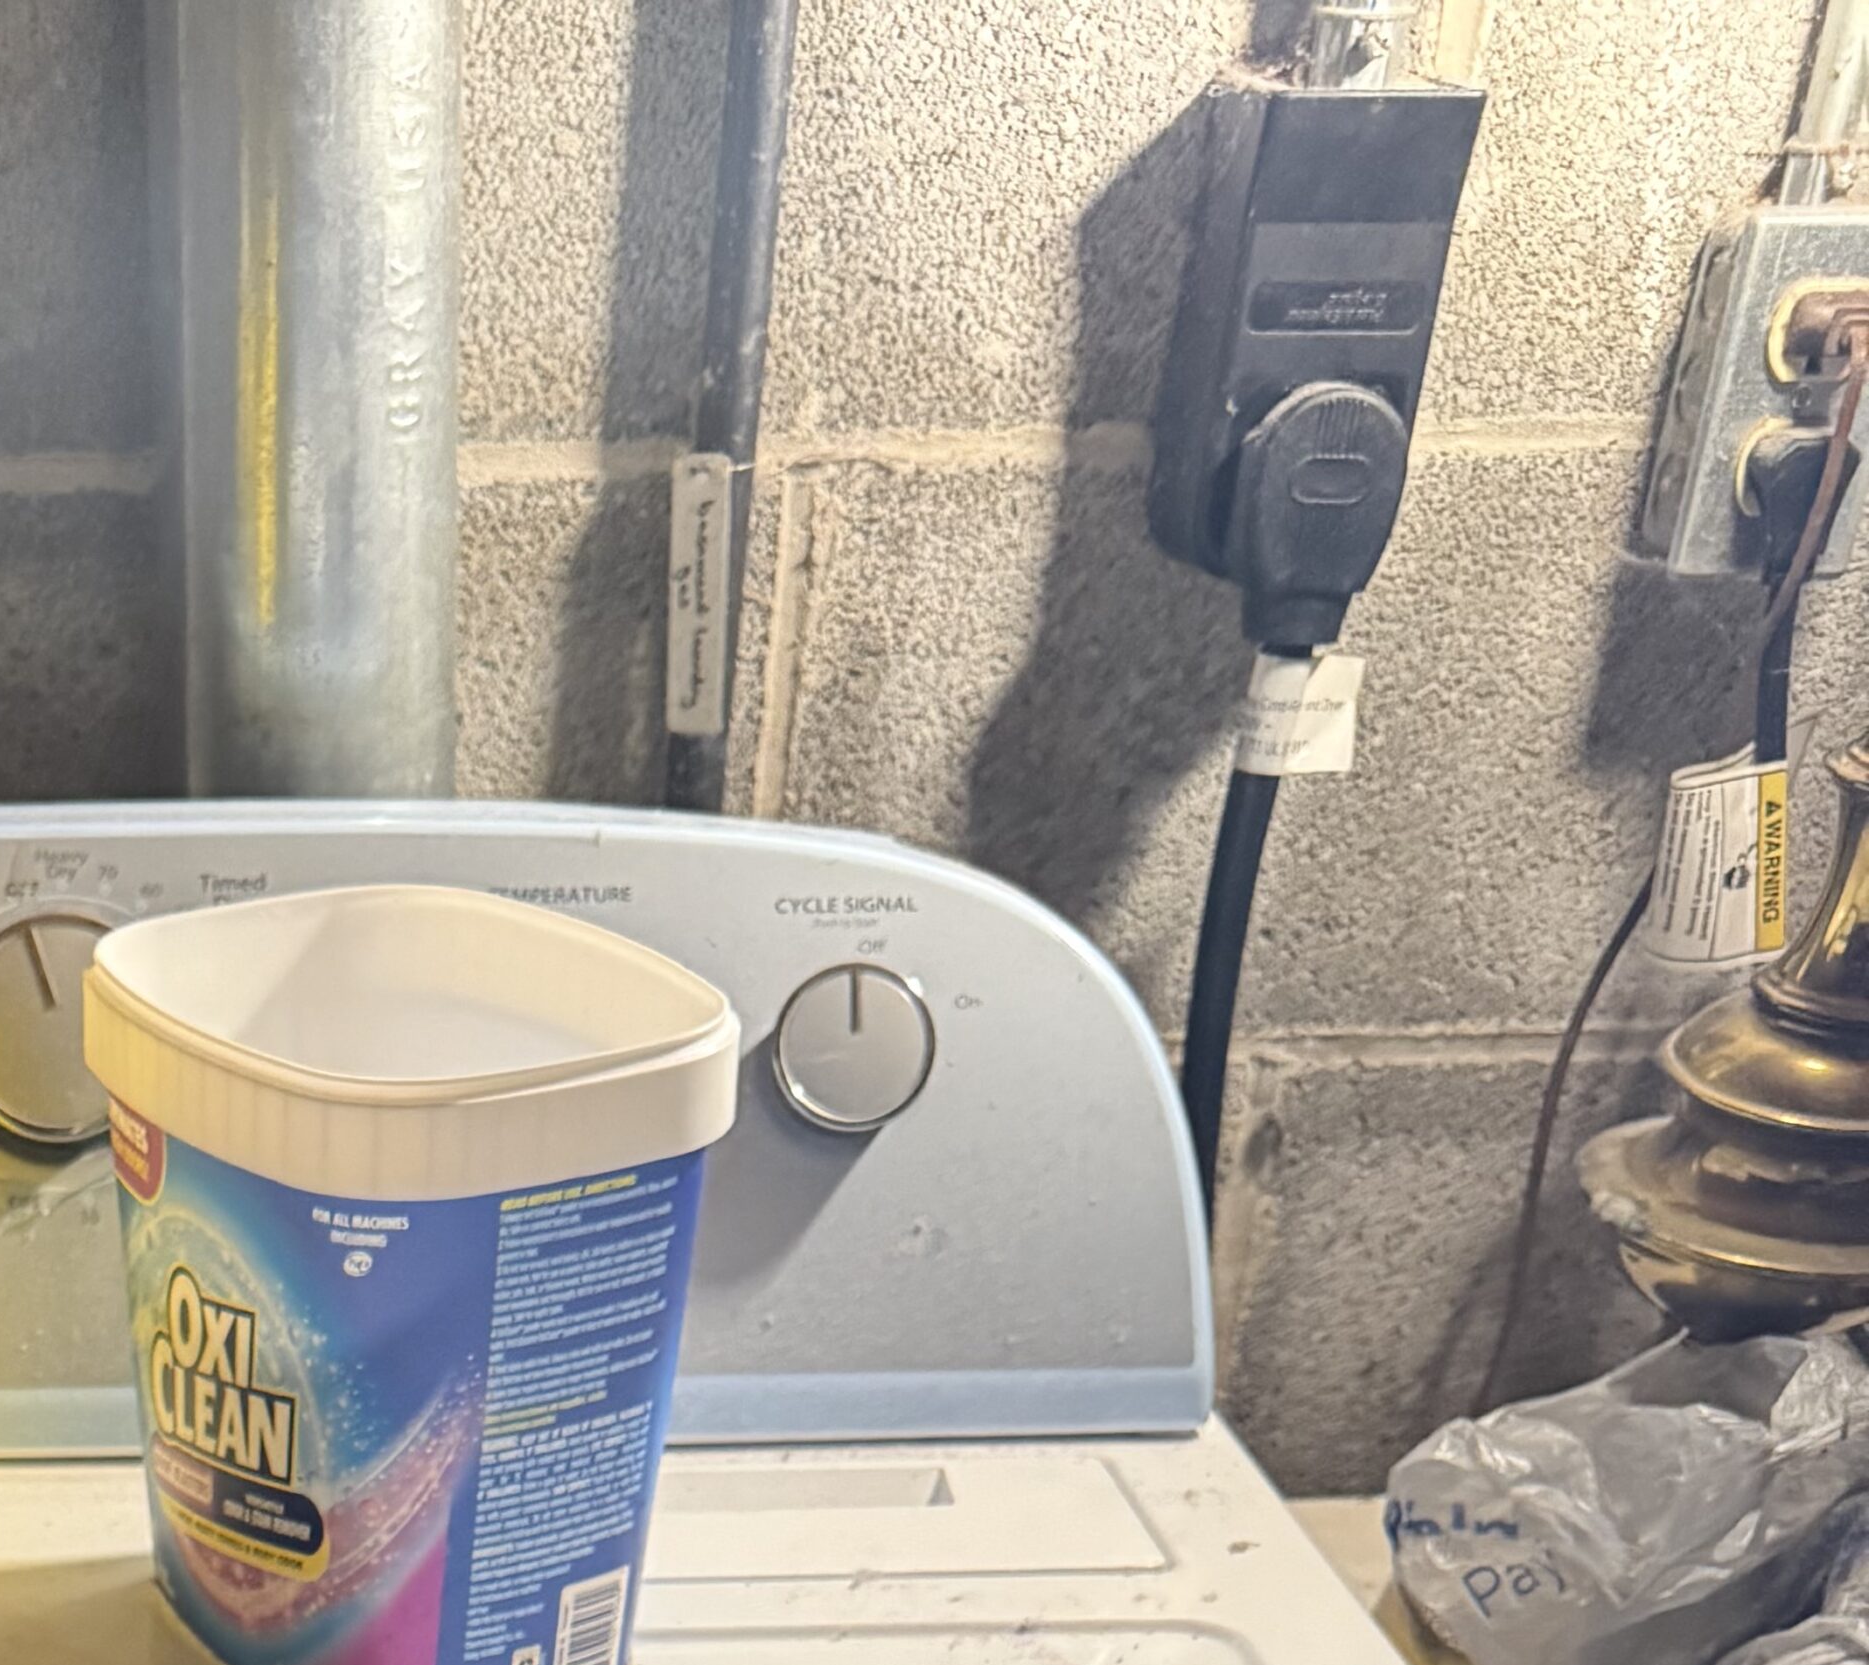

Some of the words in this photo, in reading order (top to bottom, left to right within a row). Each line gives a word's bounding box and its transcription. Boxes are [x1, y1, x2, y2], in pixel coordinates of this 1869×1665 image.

[199, 872, 269, 894] Timed
[774, 896, 840, 915] CYCLE
[842, 896, 919, 915] SIGNAL
[1762, 818, 1783, 925] WARNING
[168, 1268, 253, 1391] OXI
[151, 1334, 295, 1482] CLEAN
